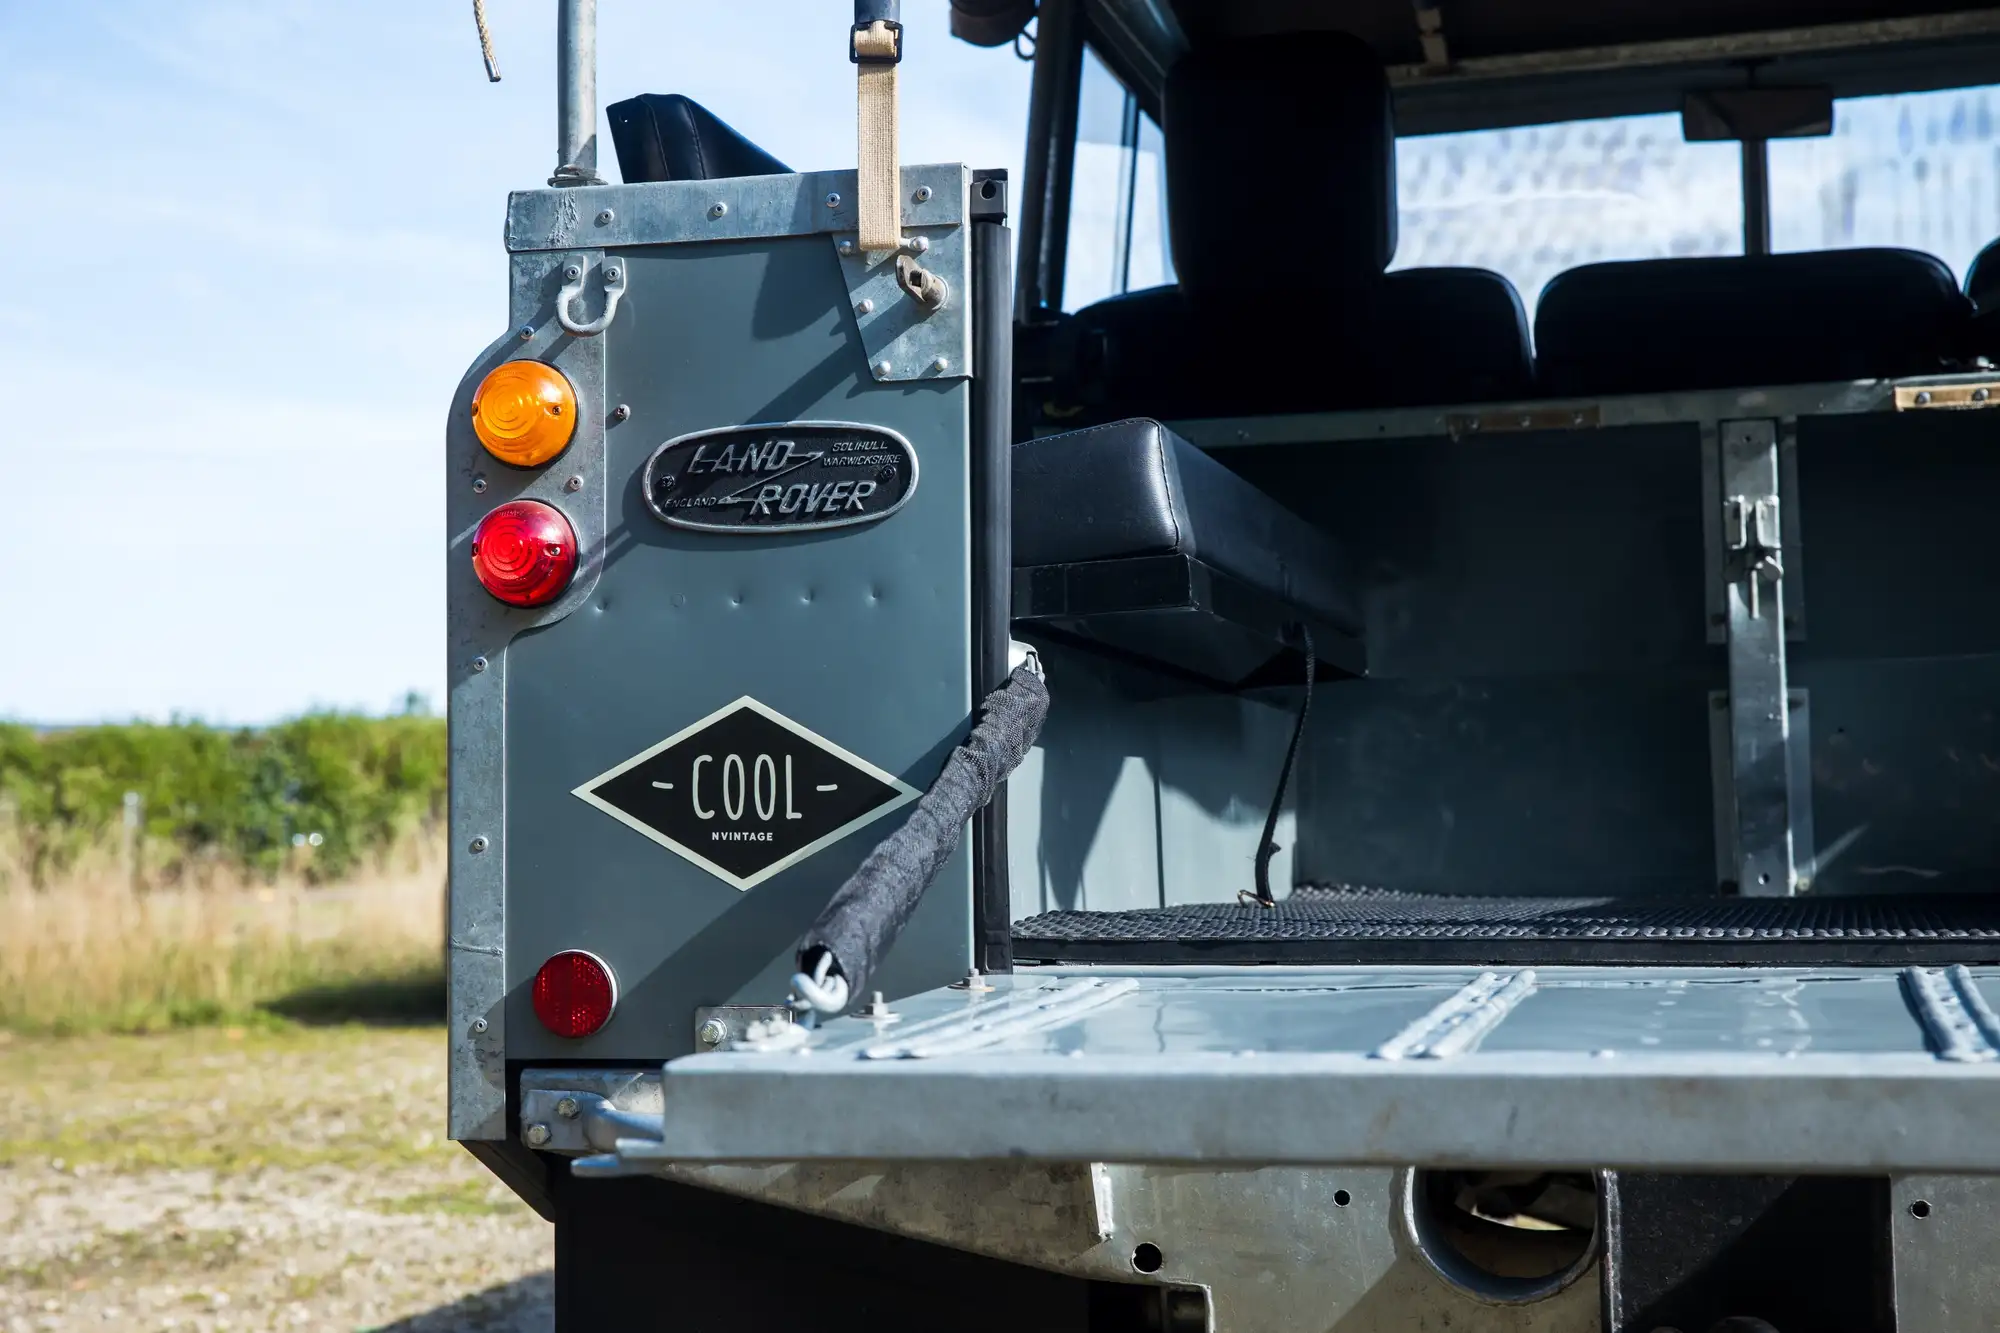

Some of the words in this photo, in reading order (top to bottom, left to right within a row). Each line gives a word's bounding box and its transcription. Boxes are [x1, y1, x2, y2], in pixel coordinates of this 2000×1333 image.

[832, 441, 888, 452] SOLIHULL
[687, 440, 795, 474] LAND
[823, 454, 901, 466] WARWICKSHIRE
[664, 497, 717, 508] ENGLAND
[751, 480, 877, 516] ROVER
[693, 754, 802, 820] COOL
[712, 832, 773, 841] NVINTAGE
